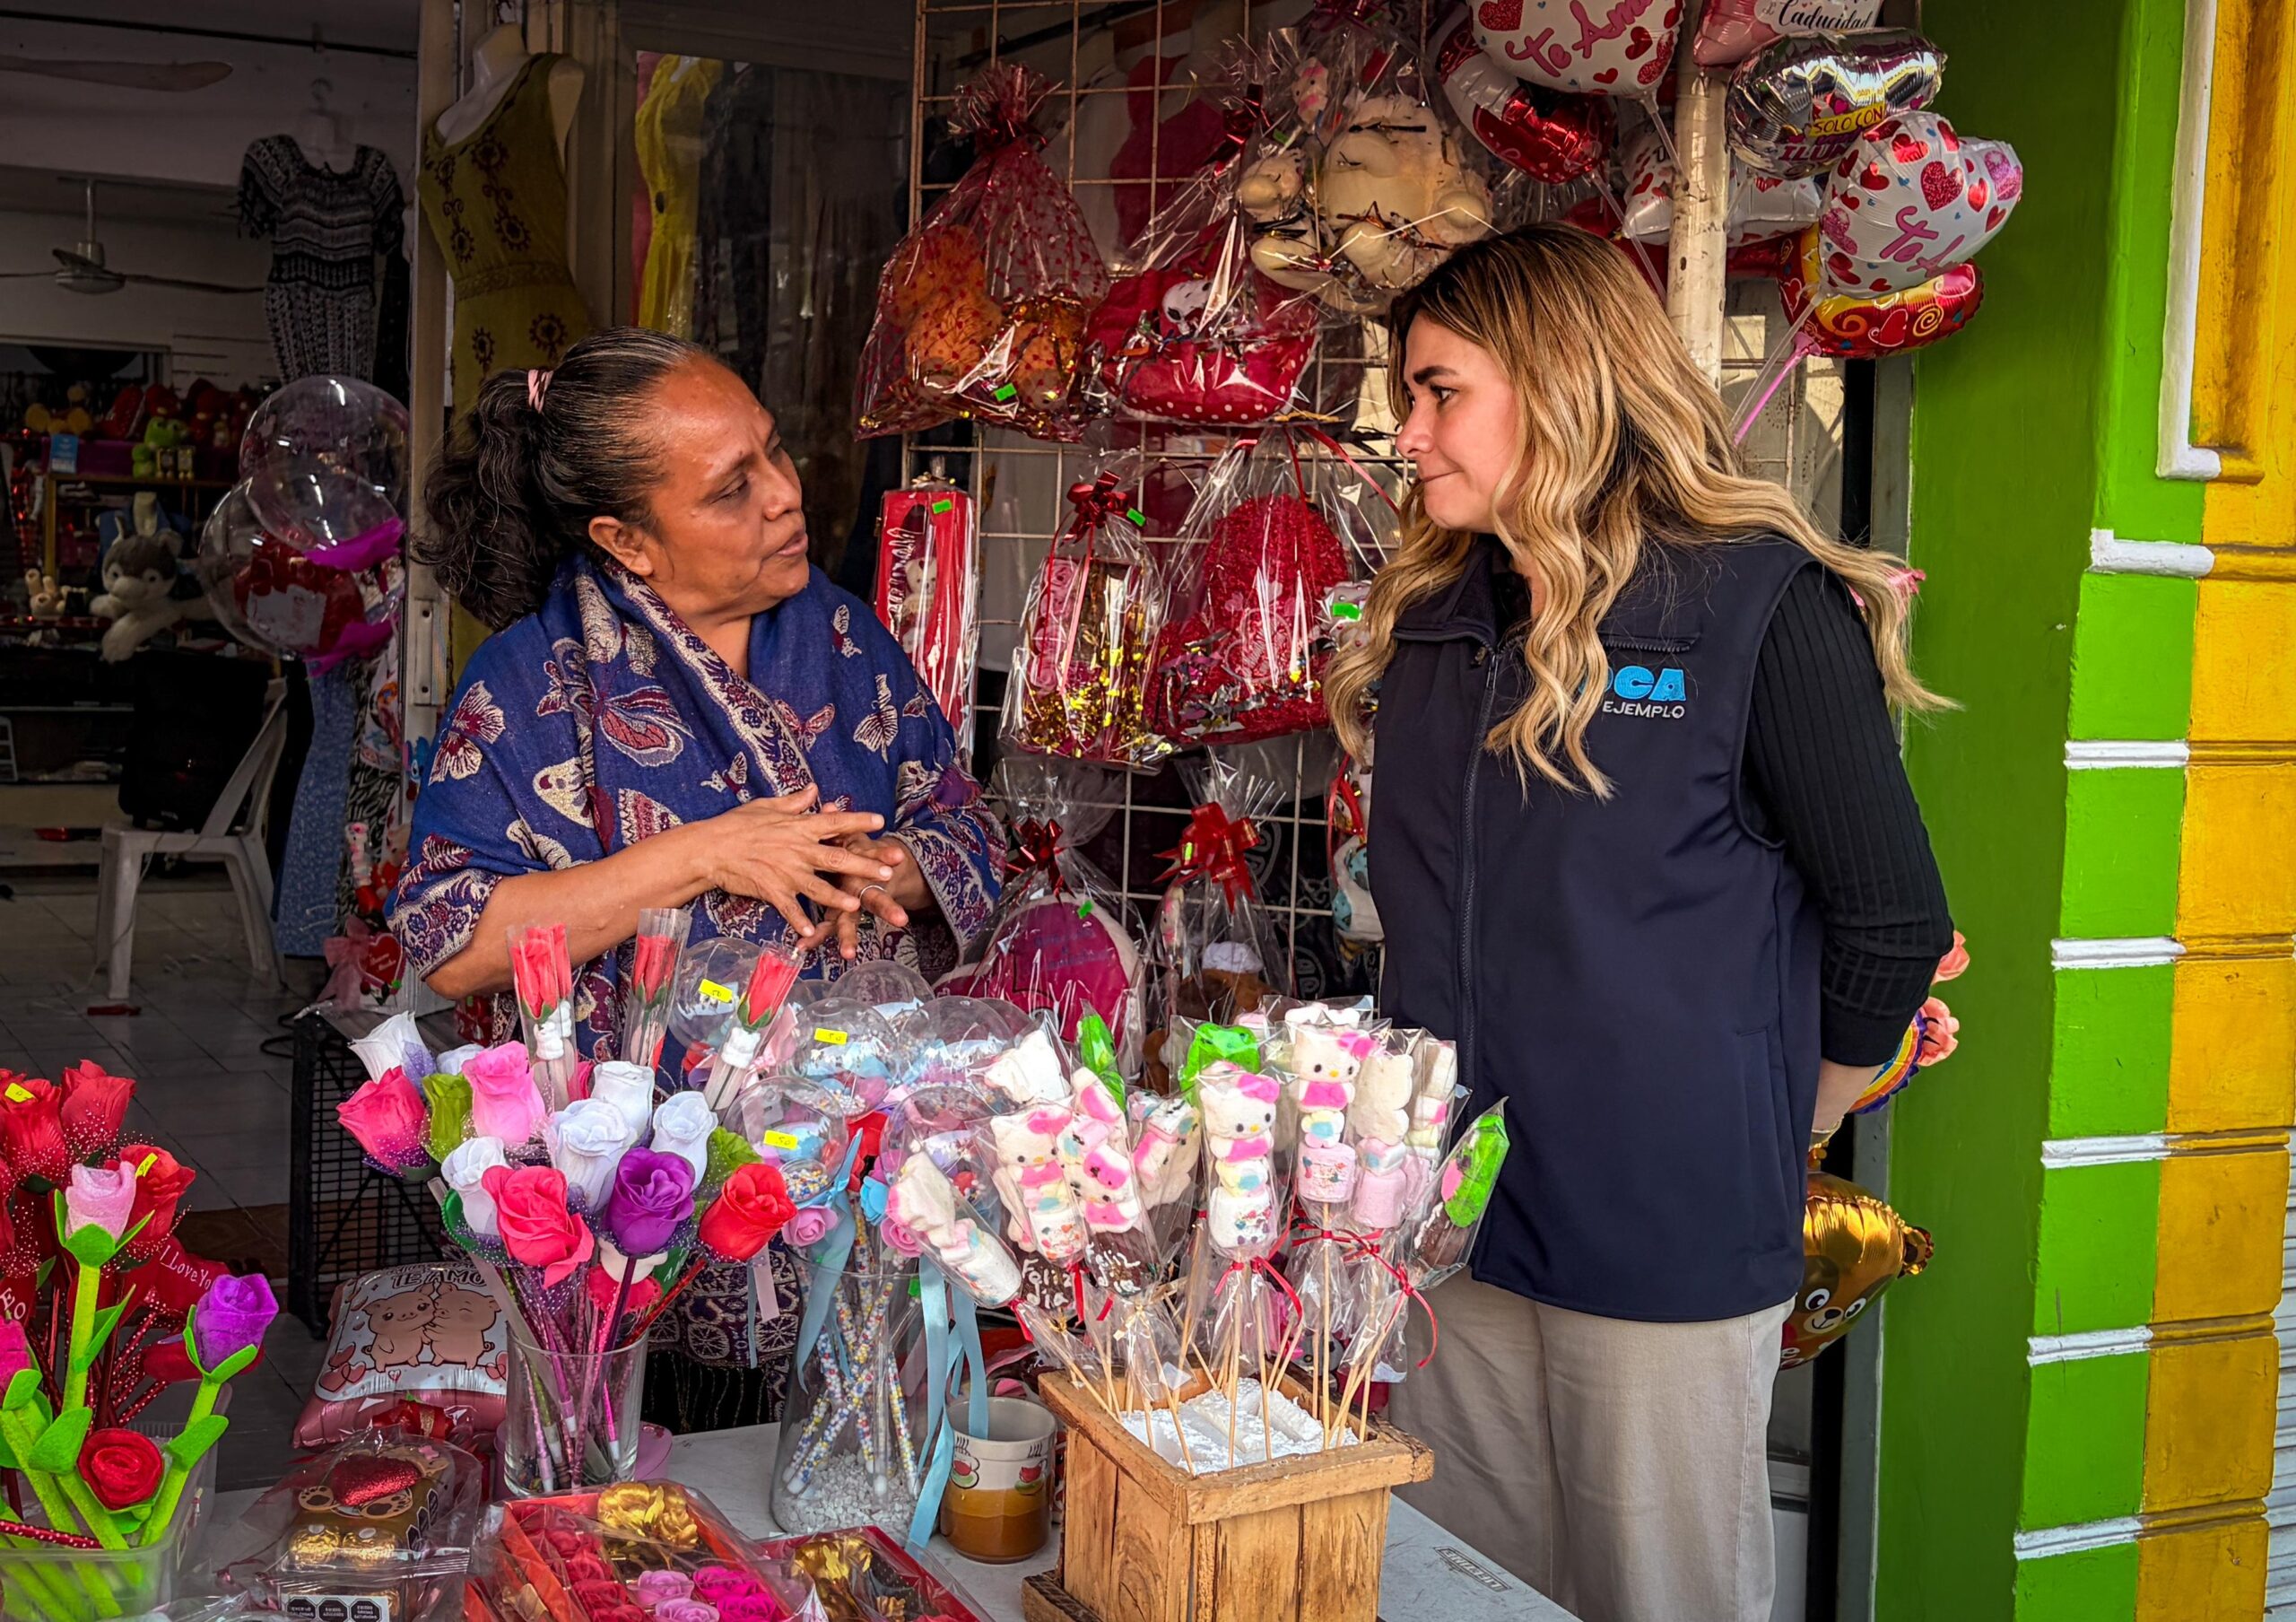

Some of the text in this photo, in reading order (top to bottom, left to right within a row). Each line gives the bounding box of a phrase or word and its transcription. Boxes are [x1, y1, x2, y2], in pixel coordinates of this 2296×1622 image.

[1779, 0, 1873, 29] Caducidad
[1812, 105, 1884, 134] SOLO CON
[1602, 701, 1685, 719] EJEMPLO
[197, 1268, 213, 1291] Yo
[391, 1270, 422, 1289] TE
[424, 1268, 488, 1289] AMO
[1441, 1550, 1504, 1590] LIFETIME
